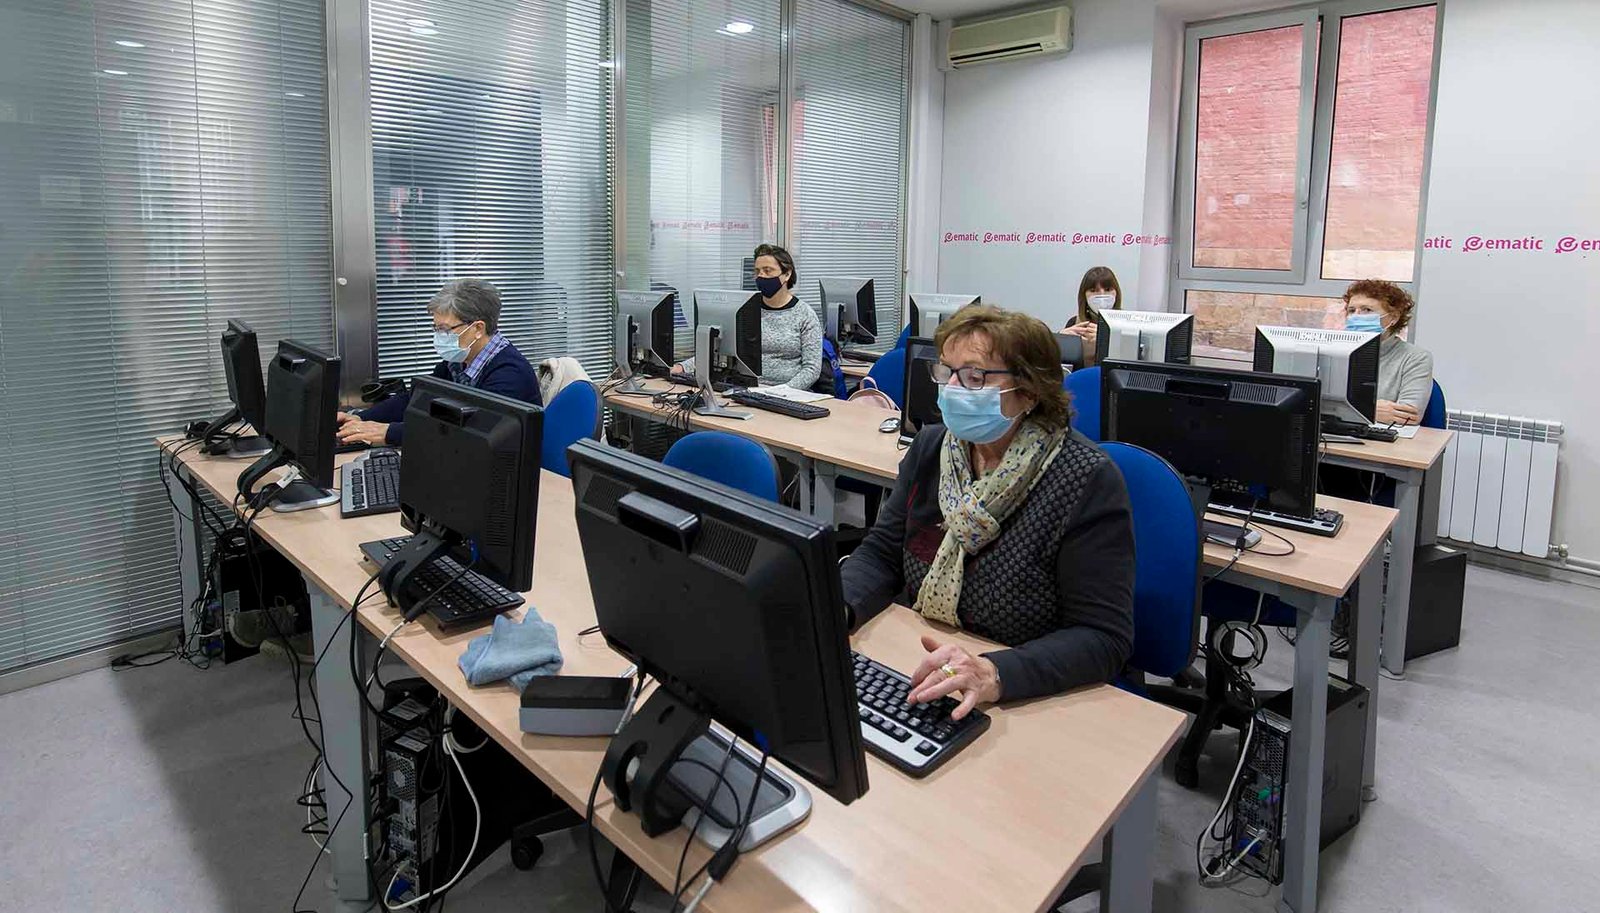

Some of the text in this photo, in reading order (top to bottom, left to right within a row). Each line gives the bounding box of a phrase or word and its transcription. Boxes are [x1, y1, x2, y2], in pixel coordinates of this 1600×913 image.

[993, 232, 1020, 242] ematic
[1036, 232, 1066, 243] ematic
[1084, 232, 1115, 244] ematic
[1424, 235, 1452, 248] atic
[1486, 236, 1543, 250] ematic
